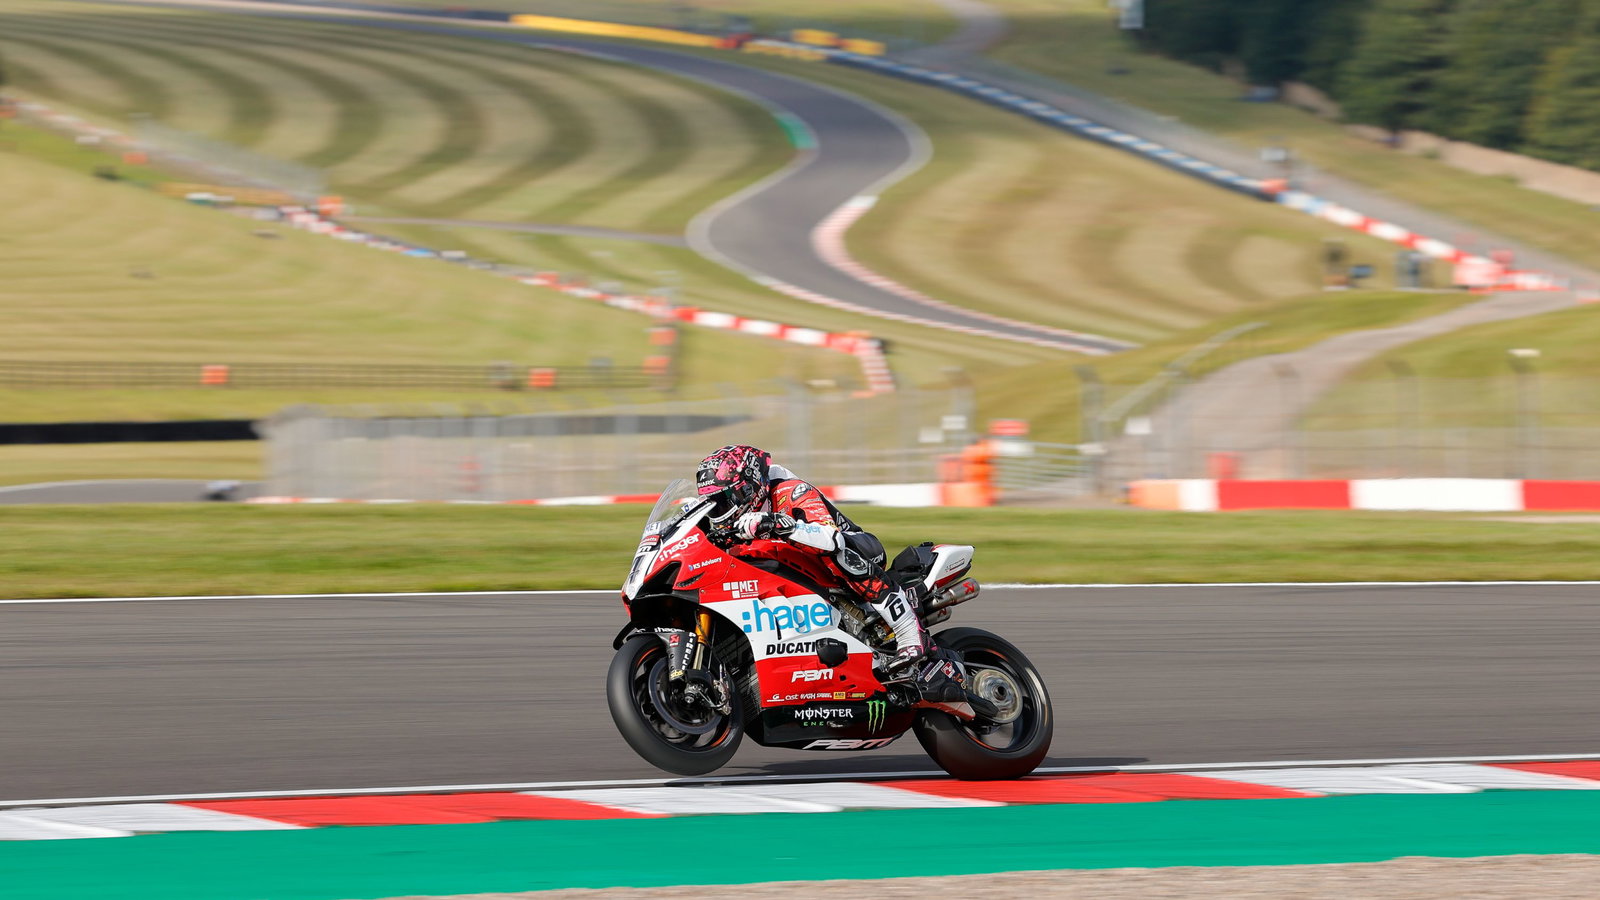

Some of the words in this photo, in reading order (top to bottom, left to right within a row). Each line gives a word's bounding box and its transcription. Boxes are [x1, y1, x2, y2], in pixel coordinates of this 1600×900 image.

[701, 557, 722, 567] Advisory
[739, 580, 759, 592] MET
[681, 631, 697, 671] PIRELLI
[765, 641, 817, 656] DUCATI
